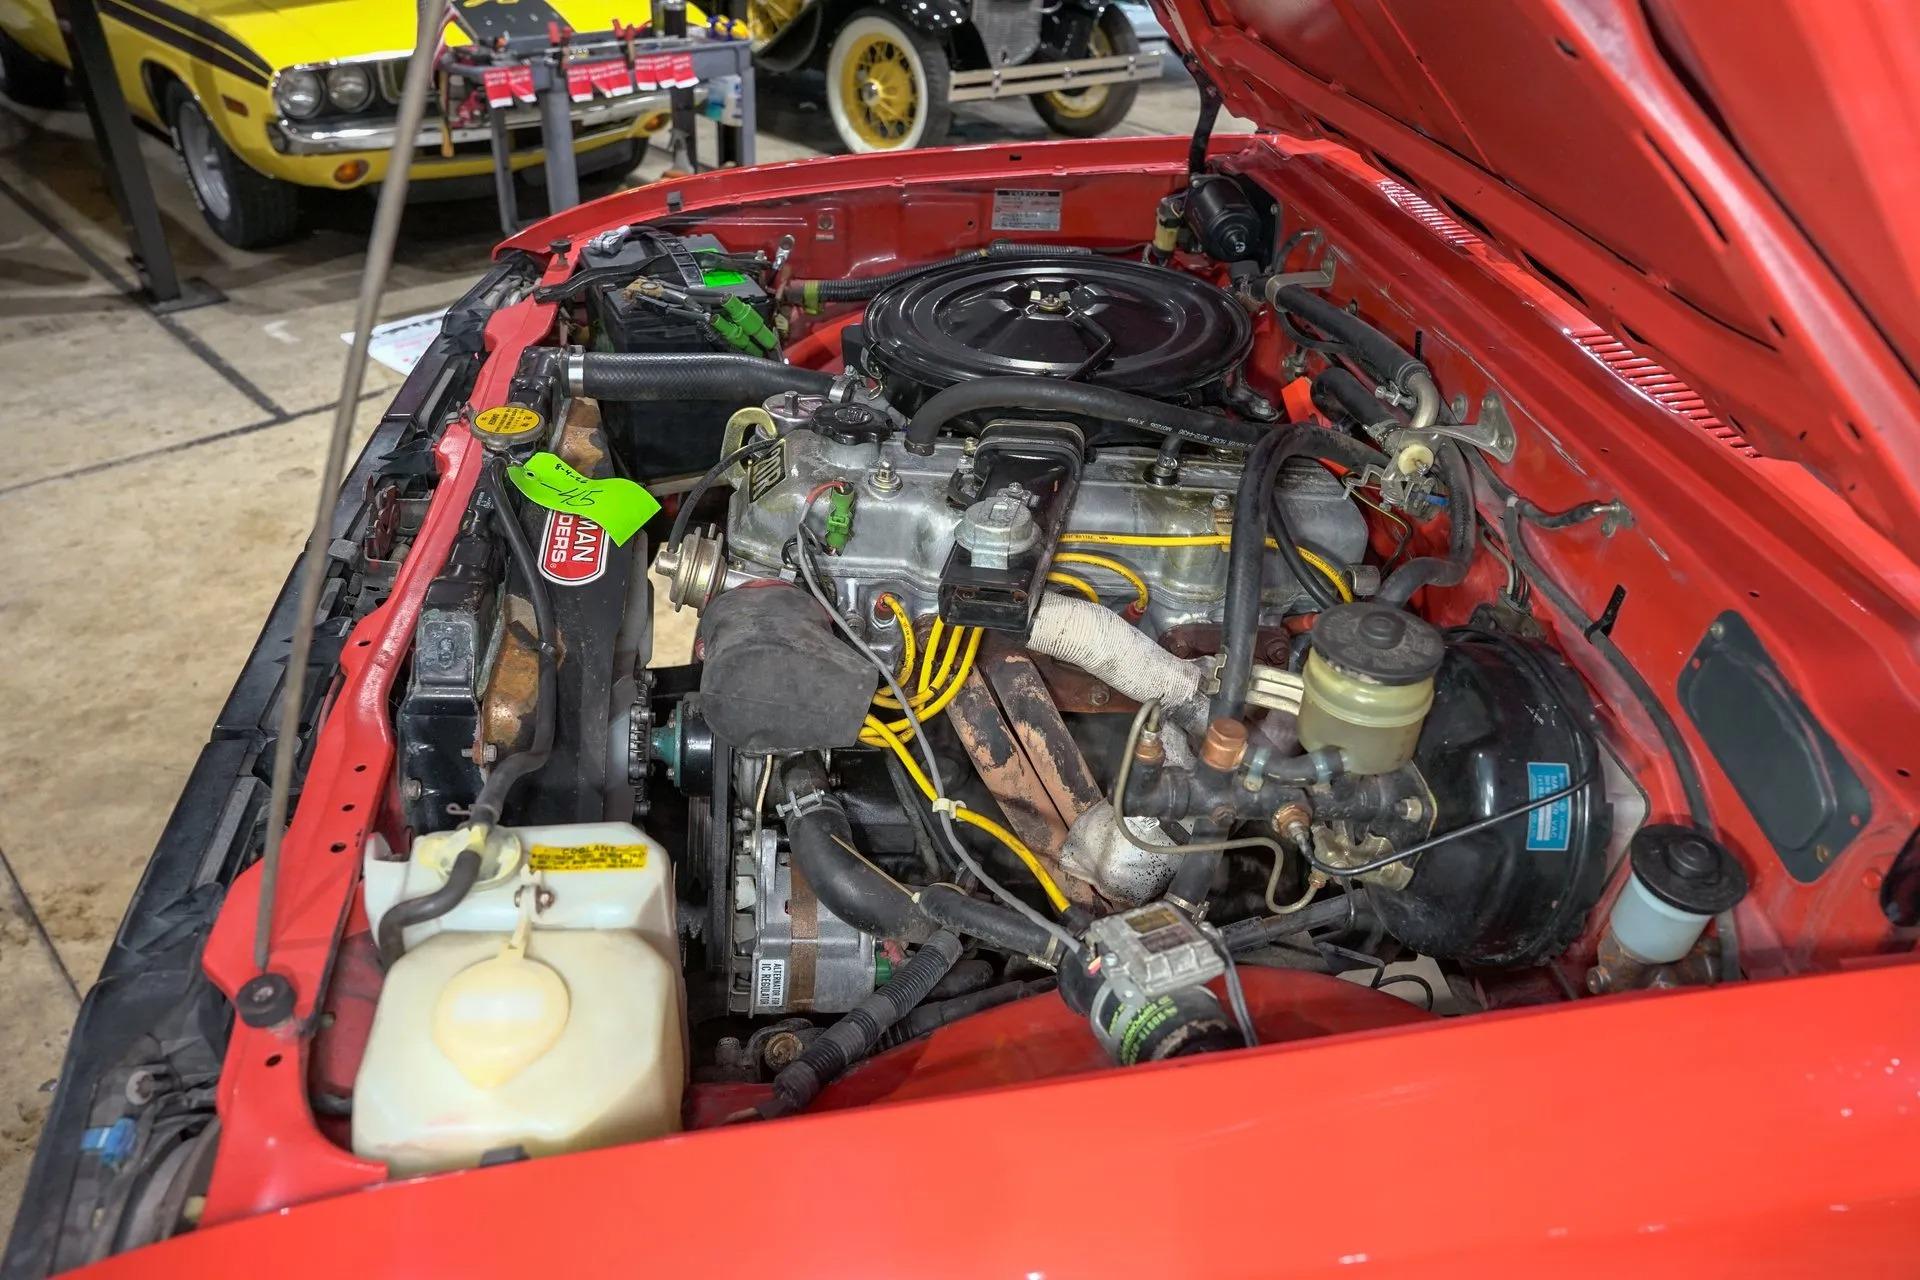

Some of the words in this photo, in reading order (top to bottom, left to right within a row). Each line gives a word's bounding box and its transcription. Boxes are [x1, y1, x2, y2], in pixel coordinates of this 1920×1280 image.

[751, 447, 781, 501] 20R
[561, 844, 617, 856] COOLANT
[761, 963, 772, 971] IC
[772, 963, 782, 996] ALTERNATOR
[760, 973, 771, 1005] REGULATOR
